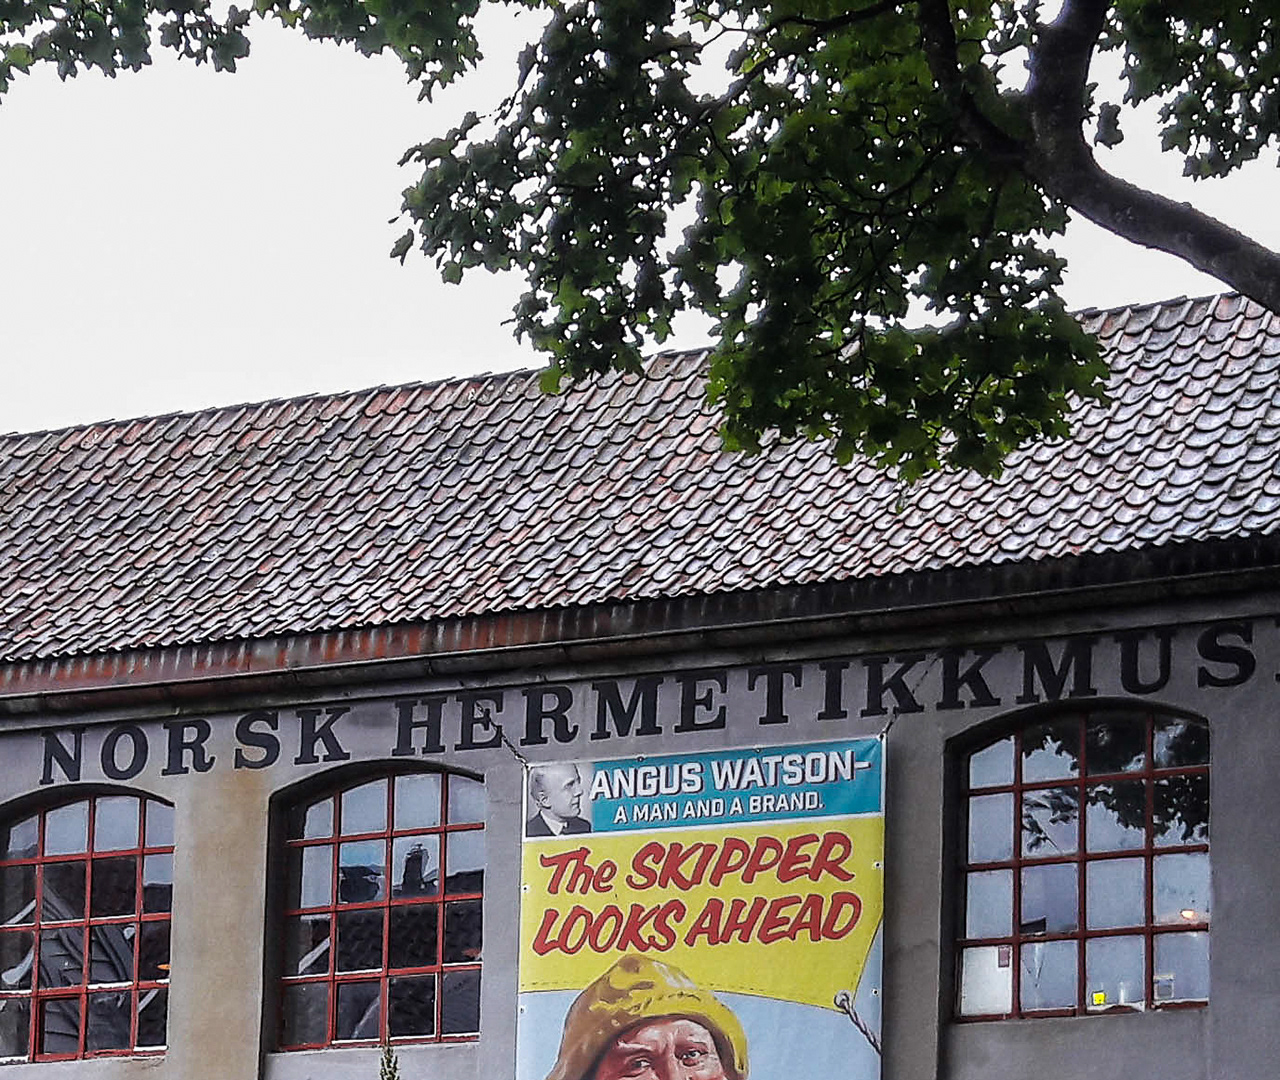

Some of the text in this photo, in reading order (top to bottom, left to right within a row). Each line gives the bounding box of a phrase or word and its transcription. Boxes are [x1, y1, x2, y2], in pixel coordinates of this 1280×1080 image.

[39, 707, 351, 786] NORSK
[589, 750, 872, 801] ANGUS WATSON-
[613, 791, 825, 825] A MAN AND A BRAND.
[540, 831, 856, 895] The SKIPPER
[532, 891, 863, 956] LOOKS AHEAD
